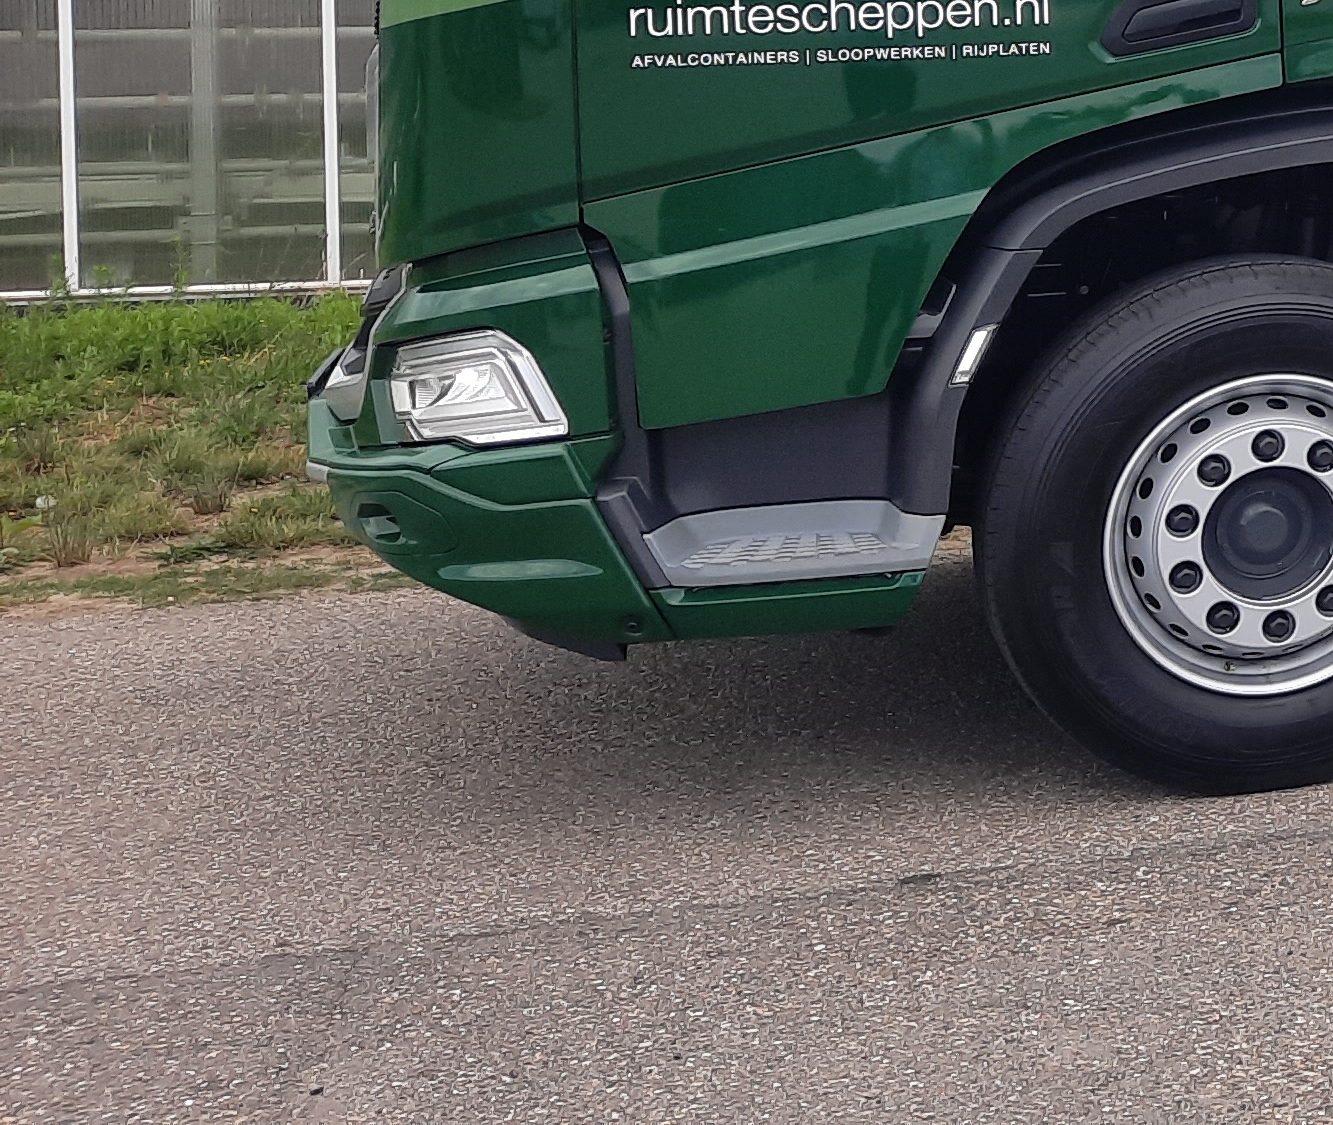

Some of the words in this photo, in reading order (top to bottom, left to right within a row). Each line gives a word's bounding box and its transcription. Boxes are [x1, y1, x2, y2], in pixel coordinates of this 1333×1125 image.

[630, 49, 801, 69] AFVALCONTAINERS
[815, 44, 947, 64] SLOOPWERKEN
[961, 40, 1051, 58] RIJPLATEN
